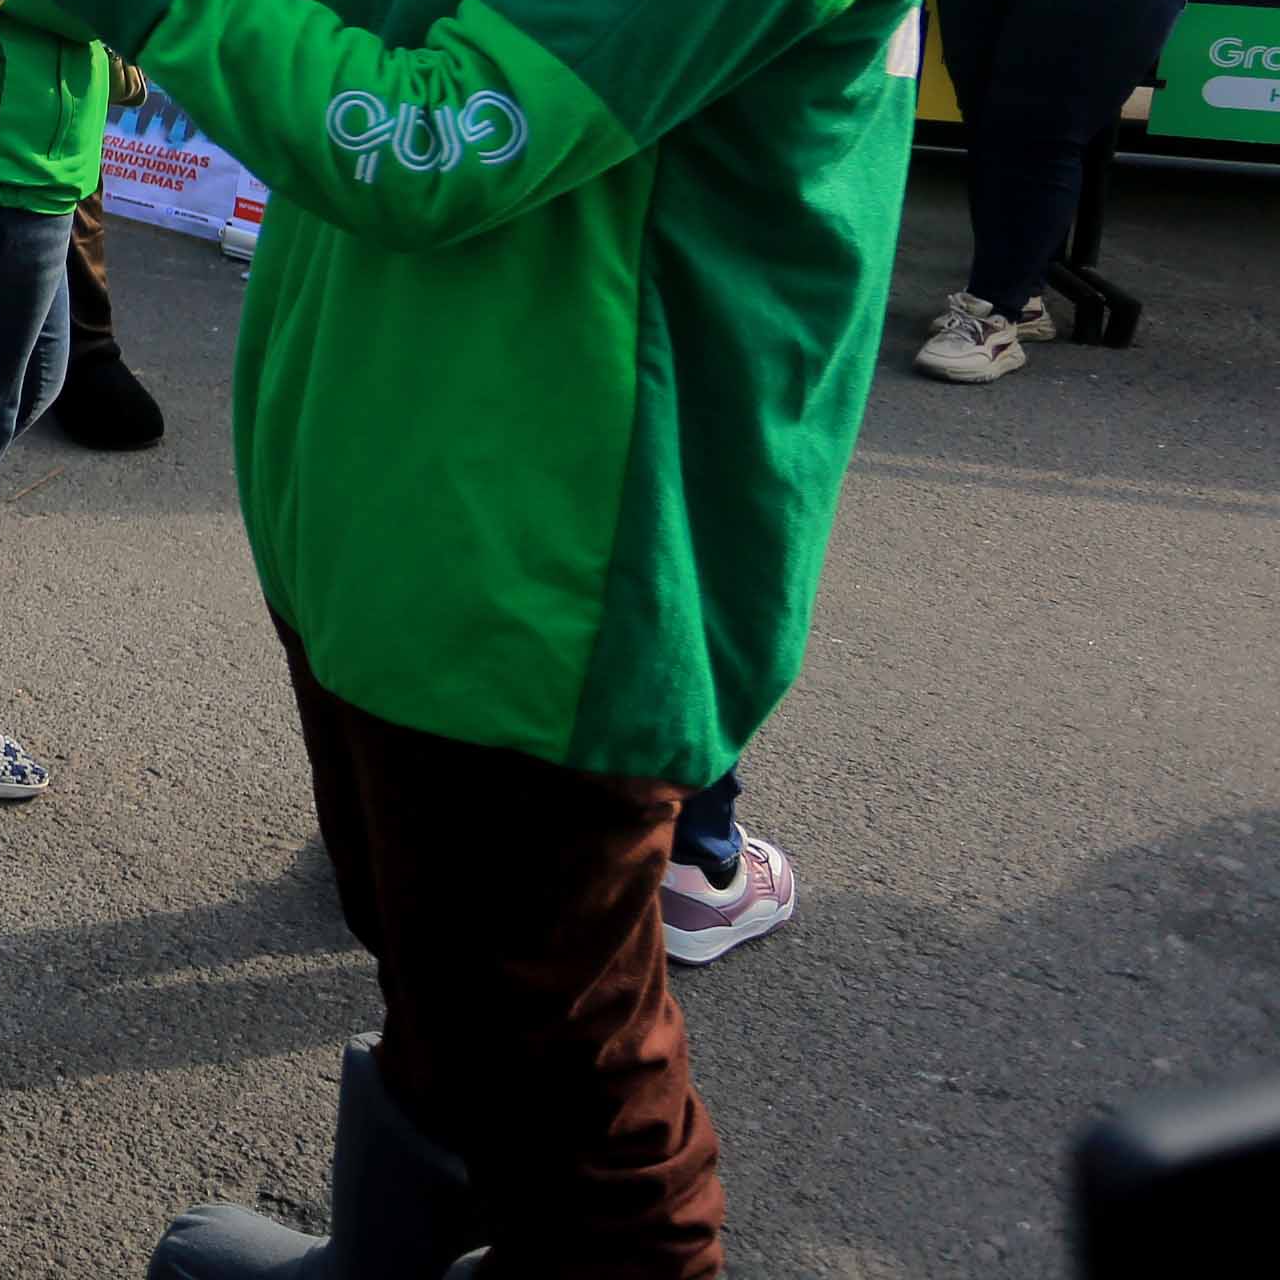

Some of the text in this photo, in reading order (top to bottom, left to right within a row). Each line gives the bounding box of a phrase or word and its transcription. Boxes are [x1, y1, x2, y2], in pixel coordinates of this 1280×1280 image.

[103, 148, 198, 181] RWUJUDNYA
[104, 135, 211, 169] ERLALU LINTAS
[140, 172, 185, 193] EMAS
